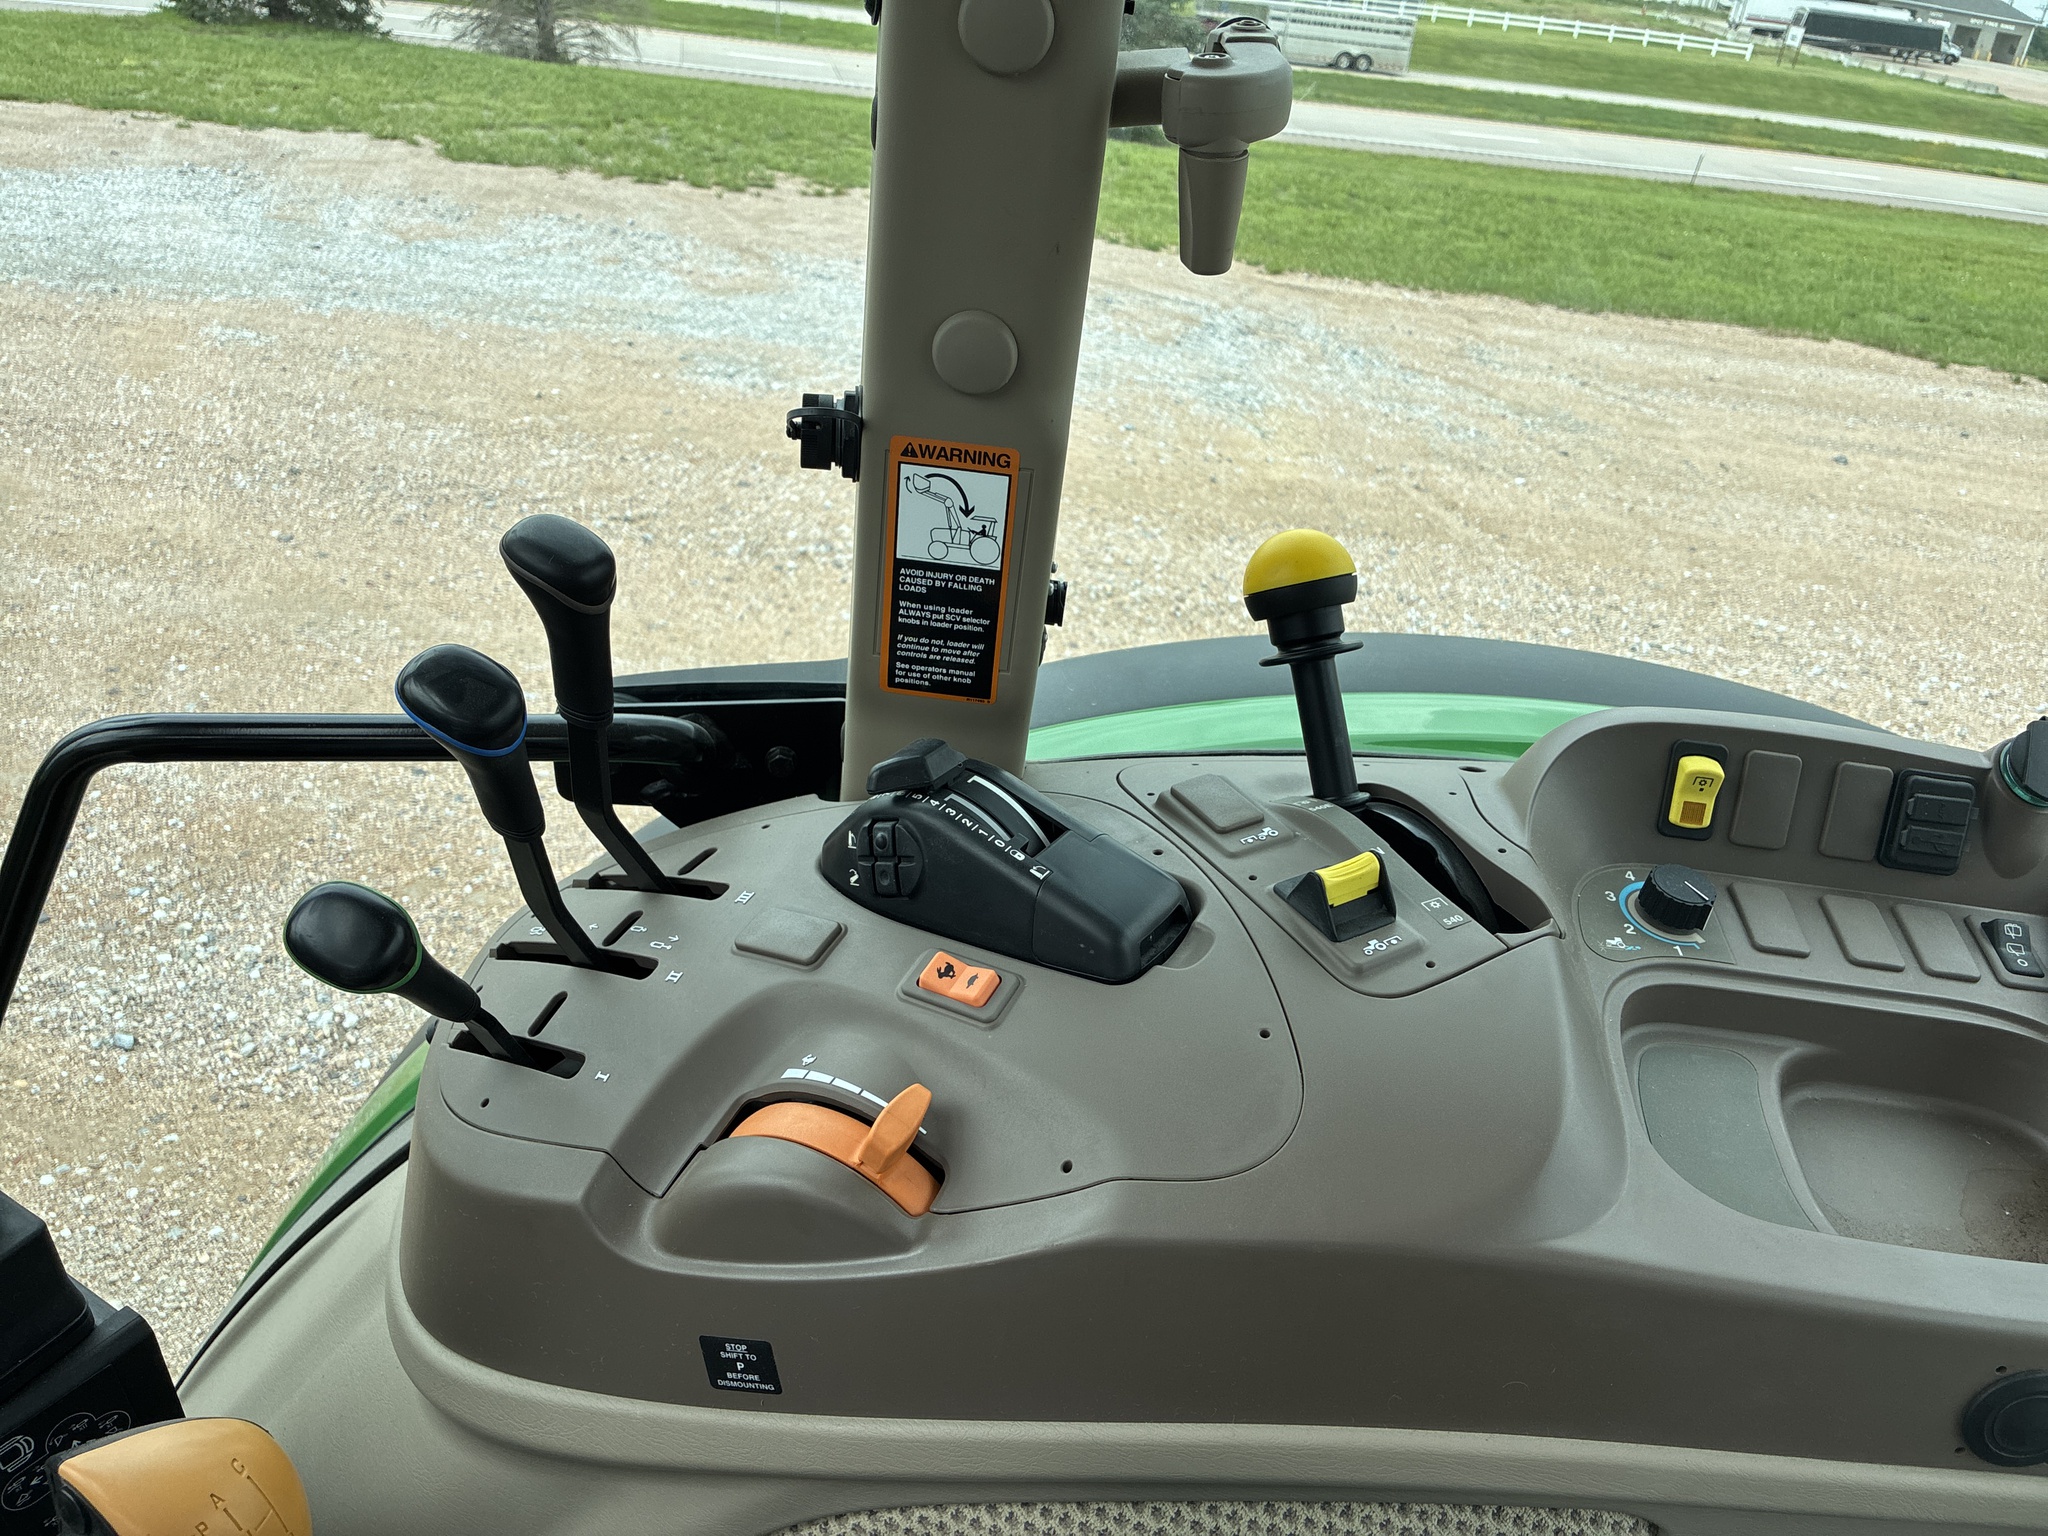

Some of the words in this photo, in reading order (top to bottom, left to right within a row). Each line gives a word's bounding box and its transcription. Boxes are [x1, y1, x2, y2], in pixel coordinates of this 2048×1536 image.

[918, 443, 1011, 469] WARNING
[900, 568, 924, 577] AVOID
[925, 571, 954, 580] INJURY
[968, 576, 995, 585] DEATH
[899, 576, 933, 586] CAUSED
[935, 580, 946, 588] BY
[947, 582, 982, 592] FALLING
[899, 584, 927, 593] LOADS
[899, 600, 922, 609] When
[923, 604, 946, 613] using
[947, 606, 973, 615] loader
[898, 608, 931, 618] ALWAYS
[932, 613, 944, 621] put
[945, 614, 961, 622] SCV
[962, 616, 990, 625] selector
[898, 616, 920, 625] knobs
[930, 620, 953, 629] loader
[953, 623, 985, 633] position.
[919, 636, 929, 644] do
[931, 639, 945, 647] not,
[946, 640, 970, 649] loader
[897, 643, 930, 652] continue
[962, 649, 980, 658] after
[897, 650, 927, 659] controls
[942, 655, 976, 665] released.
[911, 664, 947, 674] operators
[949, 668, 976, 677] manual
[895, 677, 931, 687] positions.
[932, 673, 952, 681] other
[953, 676, 971, 684] knob
[930, 799, 940, 808] 4
[945, 808, 956, 816] 3
[961, 818, 973, 827] 2
[978, 828, 989, 836] 1
[994, 840, 1006, 848] 0
[1625, 870, 1636, 881] 4
[734, 890, 755, 905] III
[1604, 891, 1617, 902] 3
[1442, 914, 1464, 926] 540
[1623, 923, 1637, 935] 2
[1672, 945, 1684, 956] 1
[665, 970, 684, 984] II
[725, 1343, 747, 1352] STOP
[720, 1351, 743, 1360] SHIFT
[745, 1353, 757, 1361] TO
[736, 1362, 745, 1371] P
[726, 1372, 760, 1381] BEFORE
[717, 1379, 775, 1391] DISMOUNTING
[209, 1493, 226, 1510] A
